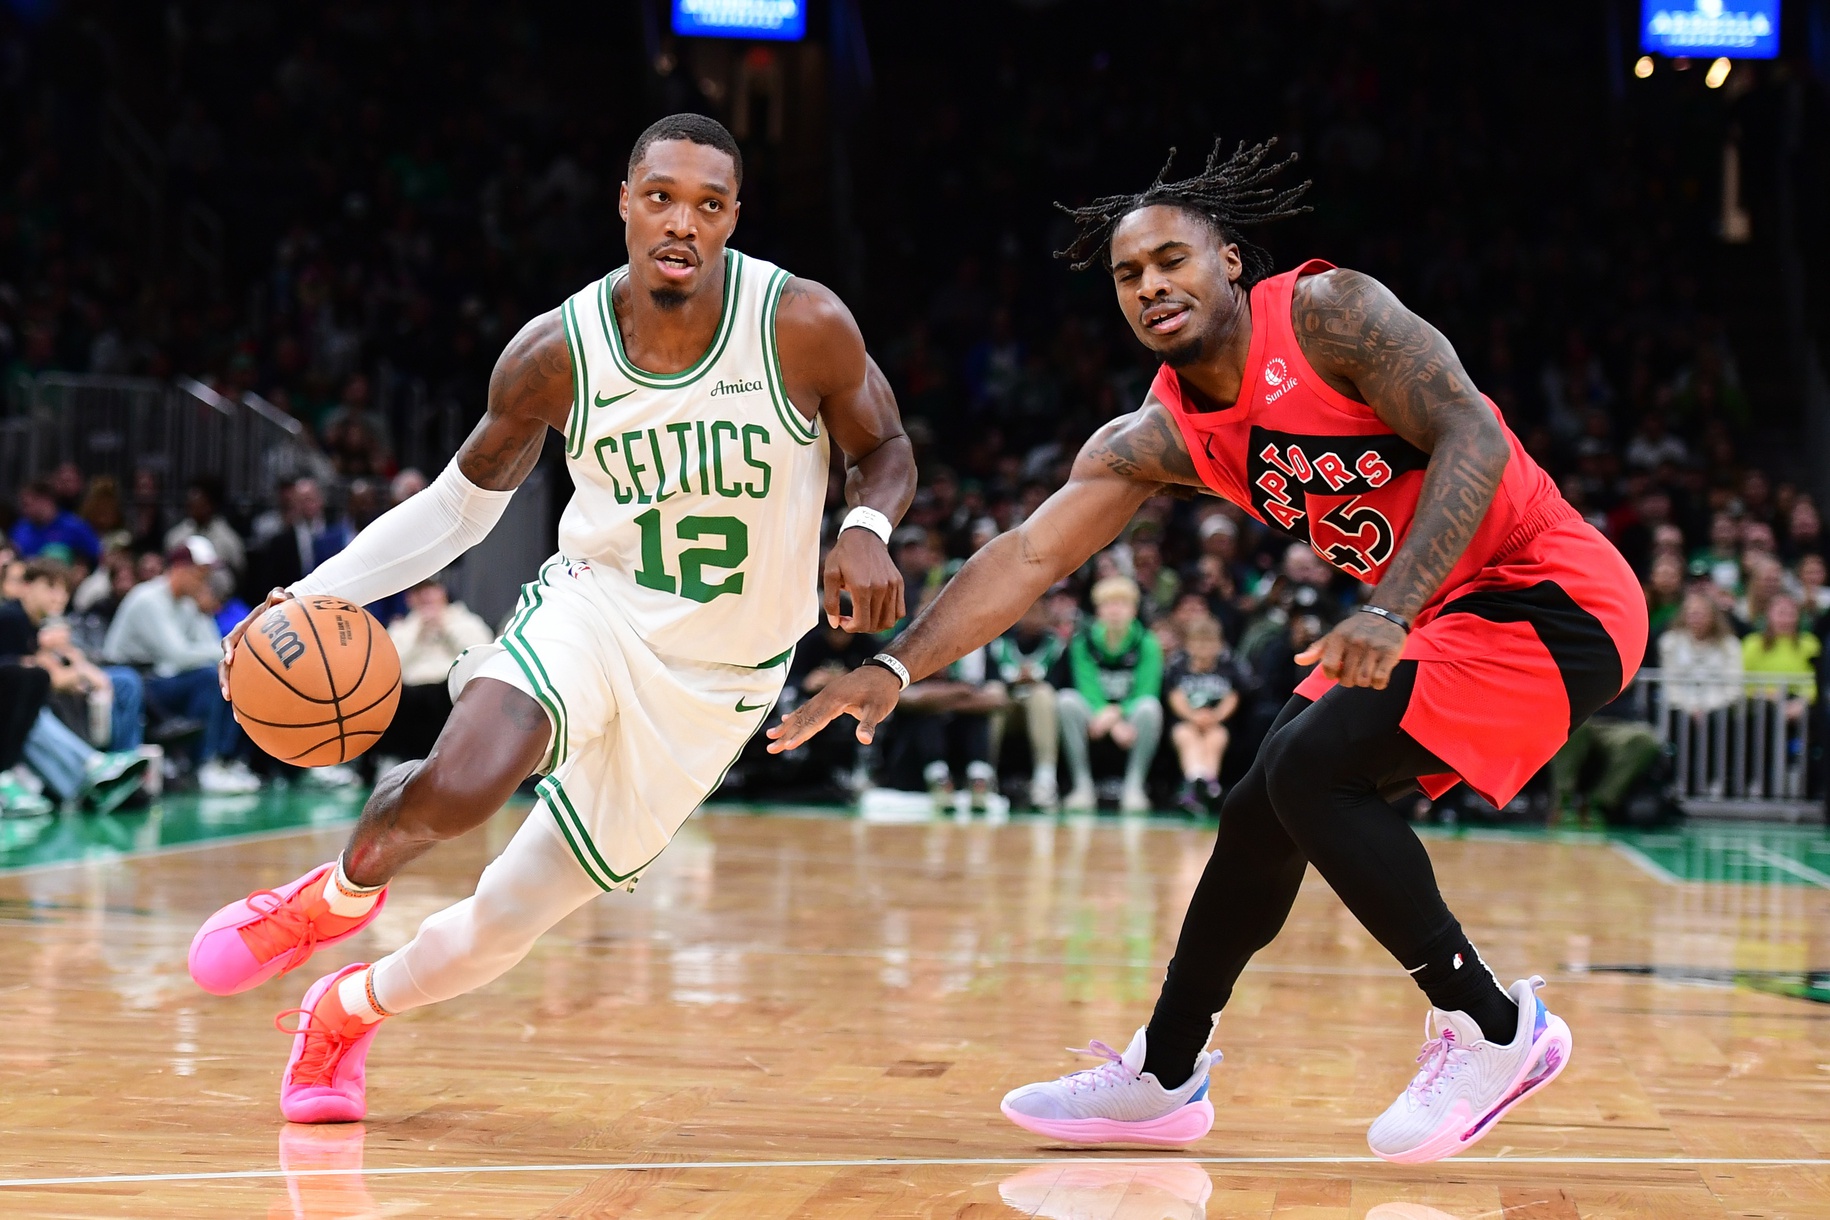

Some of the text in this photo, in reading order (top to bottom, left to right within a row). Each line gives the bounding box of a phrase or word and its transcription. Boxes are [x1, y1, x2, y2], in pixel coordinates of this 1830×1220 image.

[710, 378, 763, 397] Amica
[1265, 377, 1298, 405] Sun Life
[594, 420, 772, 505] CELTICS
[1255, 442, 1393, 530] APTORS
[633, 508, 749, 604] 12
[261, 609, 307, 671] Wils
